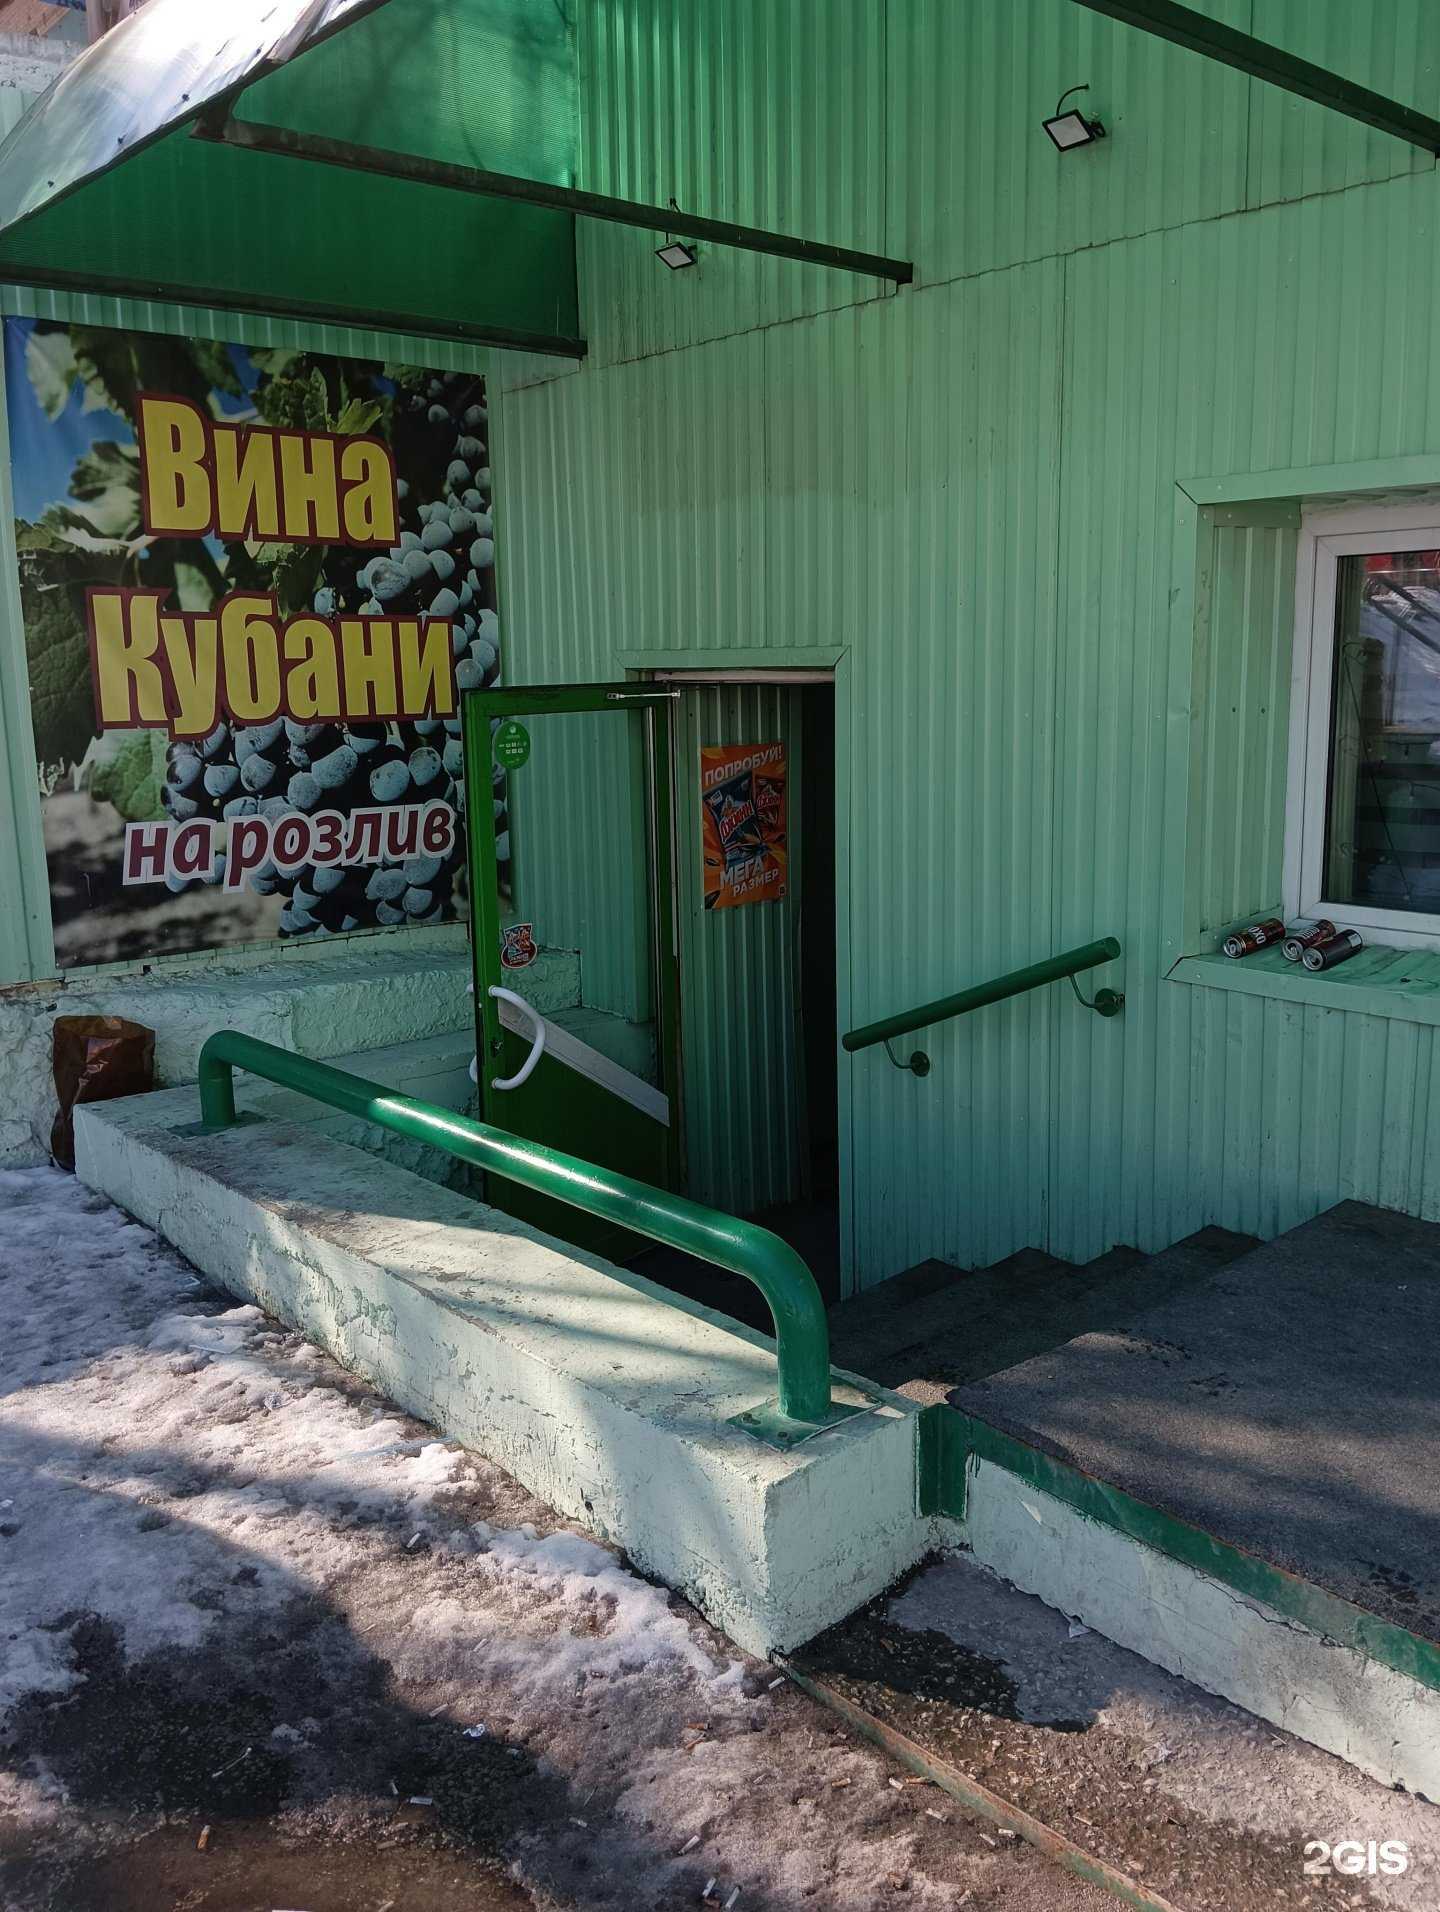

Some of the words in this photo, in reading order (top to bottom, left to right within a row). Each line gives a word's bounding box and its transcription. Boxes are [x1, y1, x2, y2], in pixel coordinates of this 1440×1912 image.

[140, 396, 398, 542] Вина
[91, 593, 455, 736] Кубани
[704, 745, 784, 786] ПОПРОБУЙ!
[126, 822, 215, 881] на
[227, 803, 455, 888] розлив
[719, 856, 765, 888] МЕГА
[732, 868, 780, 897] РАЗМЕР
